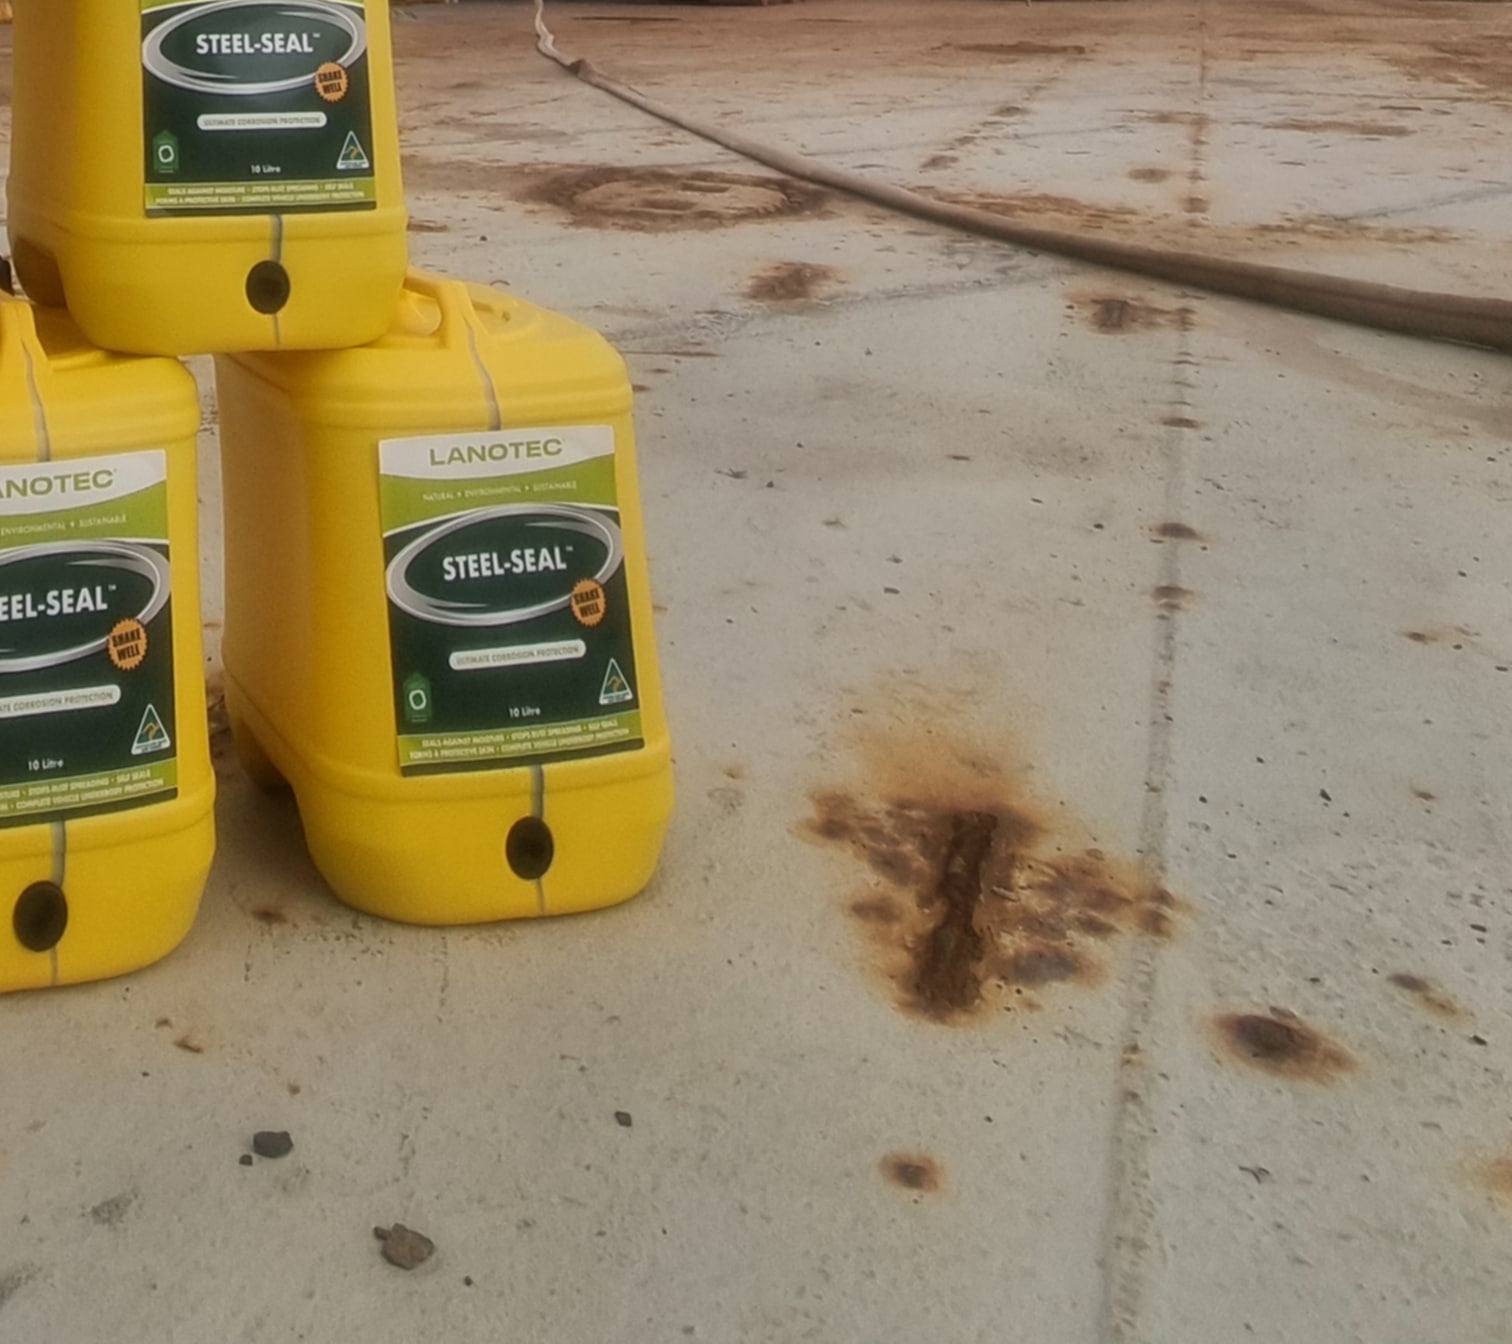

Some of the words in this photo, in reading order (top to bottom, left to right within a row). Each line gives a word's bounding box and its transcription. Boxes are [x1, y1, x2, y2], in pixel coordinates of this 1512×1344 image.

[428, 438, 563, 466] LANOTEC
[112, 627, 141, 647] SHAKE
[116, 643, 140, 661] WELL
[27, 759, 39, 771] 10
[42, 756, 63, 769] Litre
